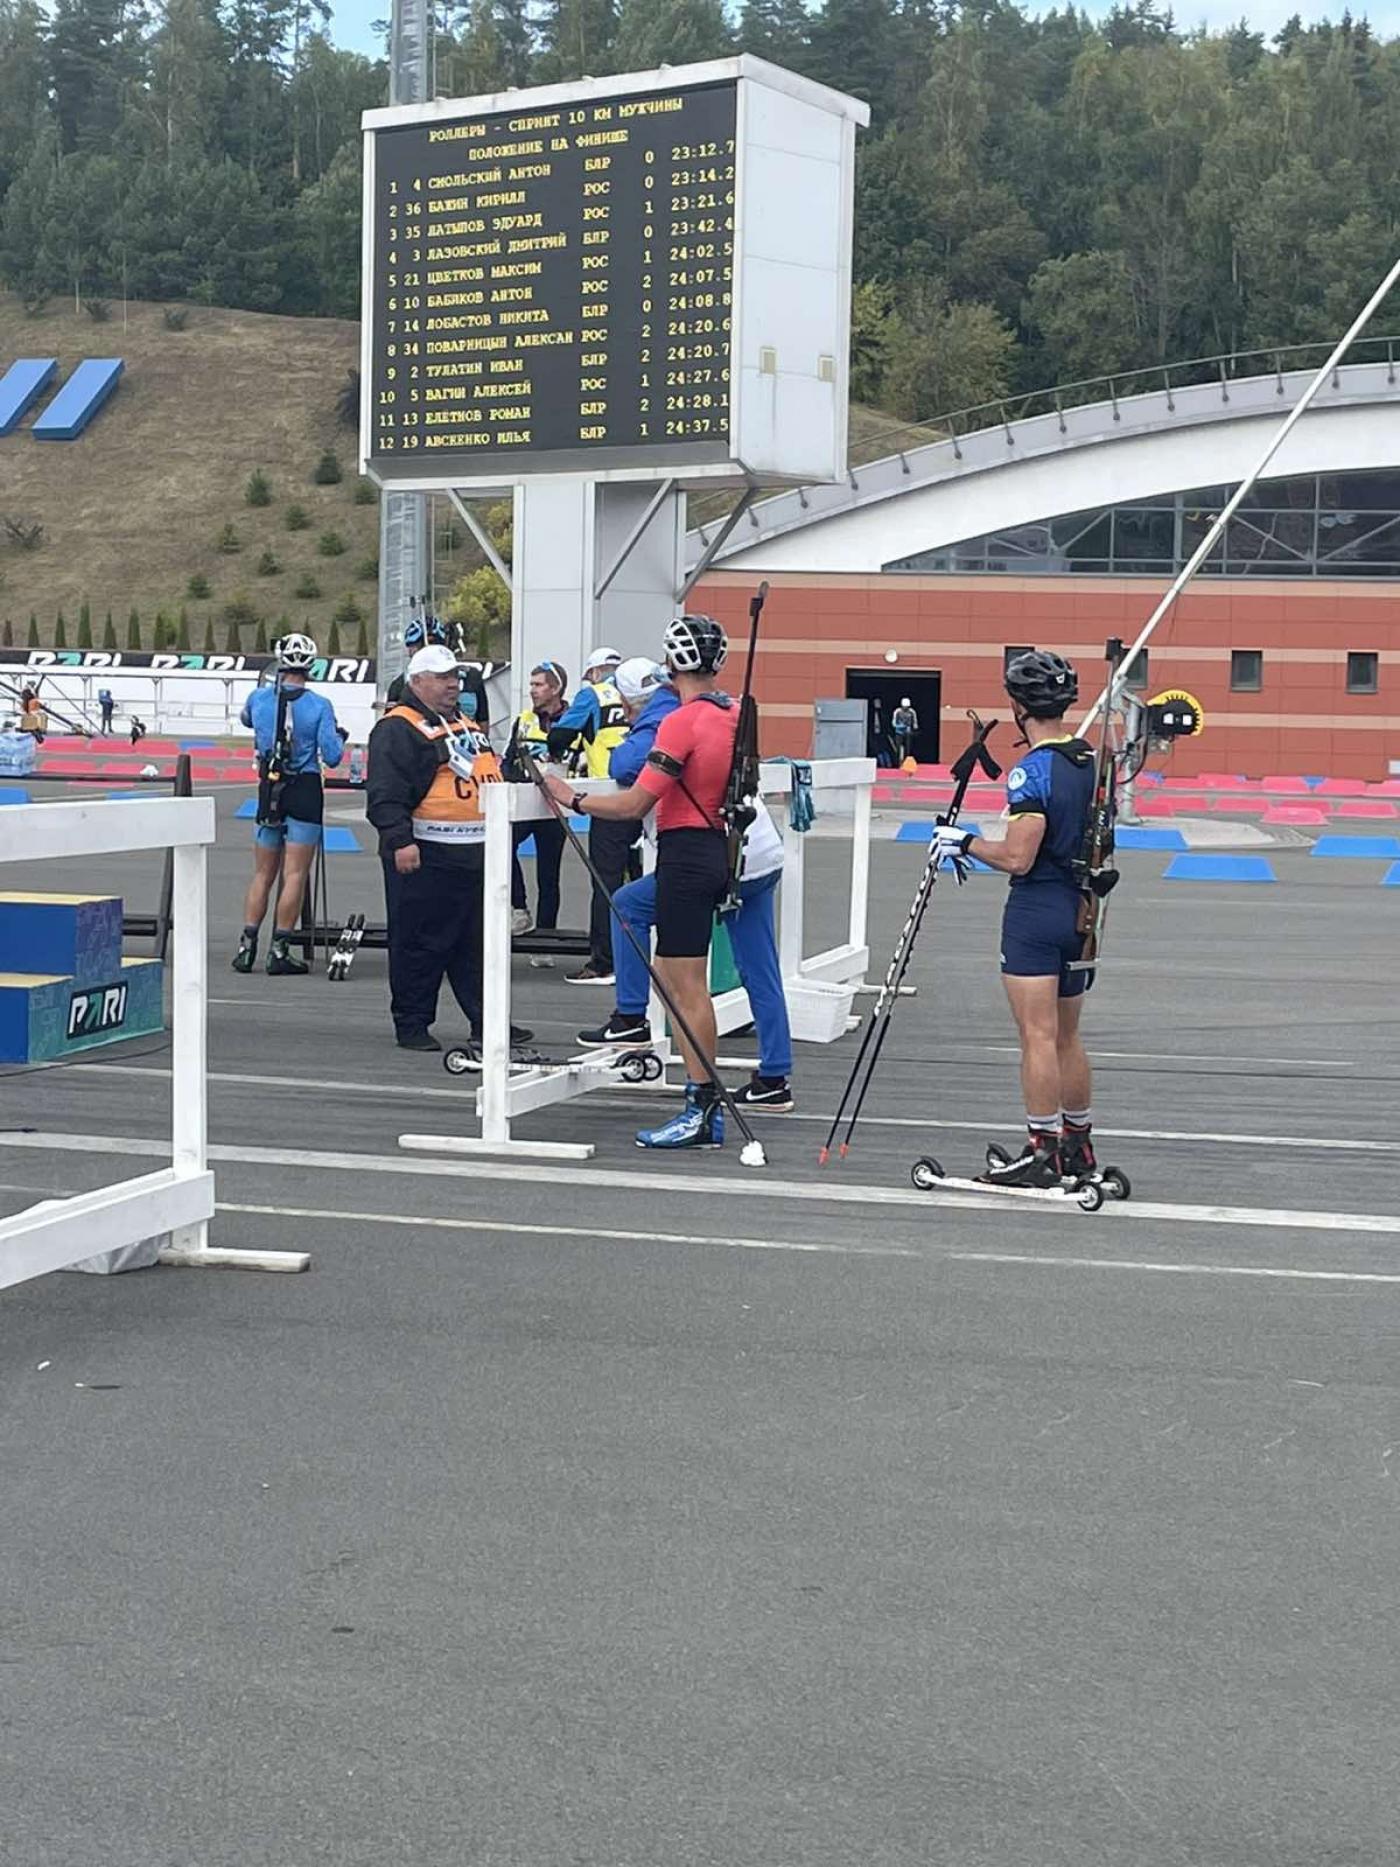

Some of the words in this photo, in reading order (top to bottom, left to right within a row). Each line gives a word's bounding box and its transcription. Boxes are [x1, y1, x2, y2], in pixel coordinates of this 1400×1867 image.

[429, 124, 486, 142] РОЛЛЕРЫ
[509, 113, 560, 132] СПРИНТ
[569, 110, 585, 124] 10
[594, 107, 611, 121] КМ
[619, 98, 683, 117] МУЖЧИНЫ
[469, 140, 543, 160] ПОЛОЖЕНИЕ
[551, 137, 569, 150] НА
[576, 129, 628, 148] ФИНИШЕ
[390, 182, 397, 193] 1
[413, 179, 421, 191] 4
[428, 167, 501, 189] СМОЛЬСКИЙ
[509, 164, 551, 180] АНТОН
[585, 157, 611, 171] БЛР
[645, 151, 654, 163] 0
[672, 140, 734, 160] 23:12.7
[389, 205, 397, 218] 2
[405, 203, 421, 215] 36
[476, 190, 526, 208] КИРИЛЛ
[583, 181, 610, 196] РОС
[645, 176, 653, 188] 0
[672, 166, 734, 185] 23:14.2
[390, 228, 397, 241] 3
[405, 226, 421, 239] 35
[427, 220, 485, 237] ЛАТЫПОВ
[492, 213, 543, 230] ЭДУАРД
[583, 206, 610, 220] РОС
[645, 201, 653, 214] 1
[671, 191, 733, 211] 23:21.6
[389, 251, 396, 264] 4
[413, 249, 420, 262] 3
[427, 239, 501, 261] ЛАЗОВСКИЙ
[508, 232, 567, 254] ДМИТРИЙ
[583, 231, 610, 245] БЛР
[644, 225, 652, 238] 0
[671, 217, 733, 236] 23:42.4
[389, 275, 396, 287] 5
[404, 273, 420, 286] 21
[427, 267, 484, 285] ЦВЕТКОВ
[491, 262, 541, 278] МАКСИМ
[582, 256, 609, 269] РОС
[644, 250, 652, 263] 1
[670, 242, 732, 261] 24:02.5
[389, 298, 396, 310] 6
[404, 296, 420, 309] 10
[427, 291, 484, 308] БАБИКОВ
[491, 287, 533, 302] АНТОН
[581, 280, 608, 294] РОС
[643, 275, 651, 288] 2
[670, 267, 732, 286] 24:07.5
[388, 321, 396, 333] 7
[404, 320, 419, 332] 14
[426, 313, 492, 330] ЛОБАСТОВ
[499, 309, 549, 325] НИКИТА
[582, 304, 608, 318] БЛР
[643, 300, 651, 312] 0
[669, 292, 731, 311] 24:08.8
[388, 344, 396, 357] 8
[403, 343, 419, 356] 34
[426, 336, 507, 354] ПОВАРНИЦЫН
[514, 331, 574, 348] АЛЕКСАН
[581, 329, 608, 343] РОС
[641, 324, 650, 338] 2
[668, 317, 730, 336] 24:20.6
[387, 367, 396, 380] 9
[410, 366, 418, 378] 2
[426, 361, 483, 378] ТУЛАТИН
[490, 359, 523, 373] ИВАН
[581, 353, 608, 367] БЛР
[641, 349, 650, 362] 2
[667, 342, 729, 361] 24:20.7
[379, 391, 395, 404] 10
[410, 389, 418, 402] 5
[425, 386, 466, 402] ВАГИН
[473, 379, 531, 398] АЛЕКСЕЙ
[580, 378, 607, 391] РОС
[641, 374, 649, 387] 1
[666, 368, 729, 385] 24:27.6
[379, 414, 395, 427] 11
[402, 413, 418, 425] 13
[489, 406, 531, 420] РОМАН
[580, 402, 607, 415] БЛР
[640, 399, 649, 411] 2
[666, 393, 729, 410] 24:28.1
[379, 437, 394, 449] 12
[402, 436, 418, 449] 19
[425, 433, 490, 448] АВСЕЕНКО
[497, 430, 531, 444] ИЛЬЯ
[580, 426, 607, 439] БЛР
[640, 423, 649, 436] 1
[666, 418, 729, 434] 24:37.5
[69, 986, 126, 1034] PARI
